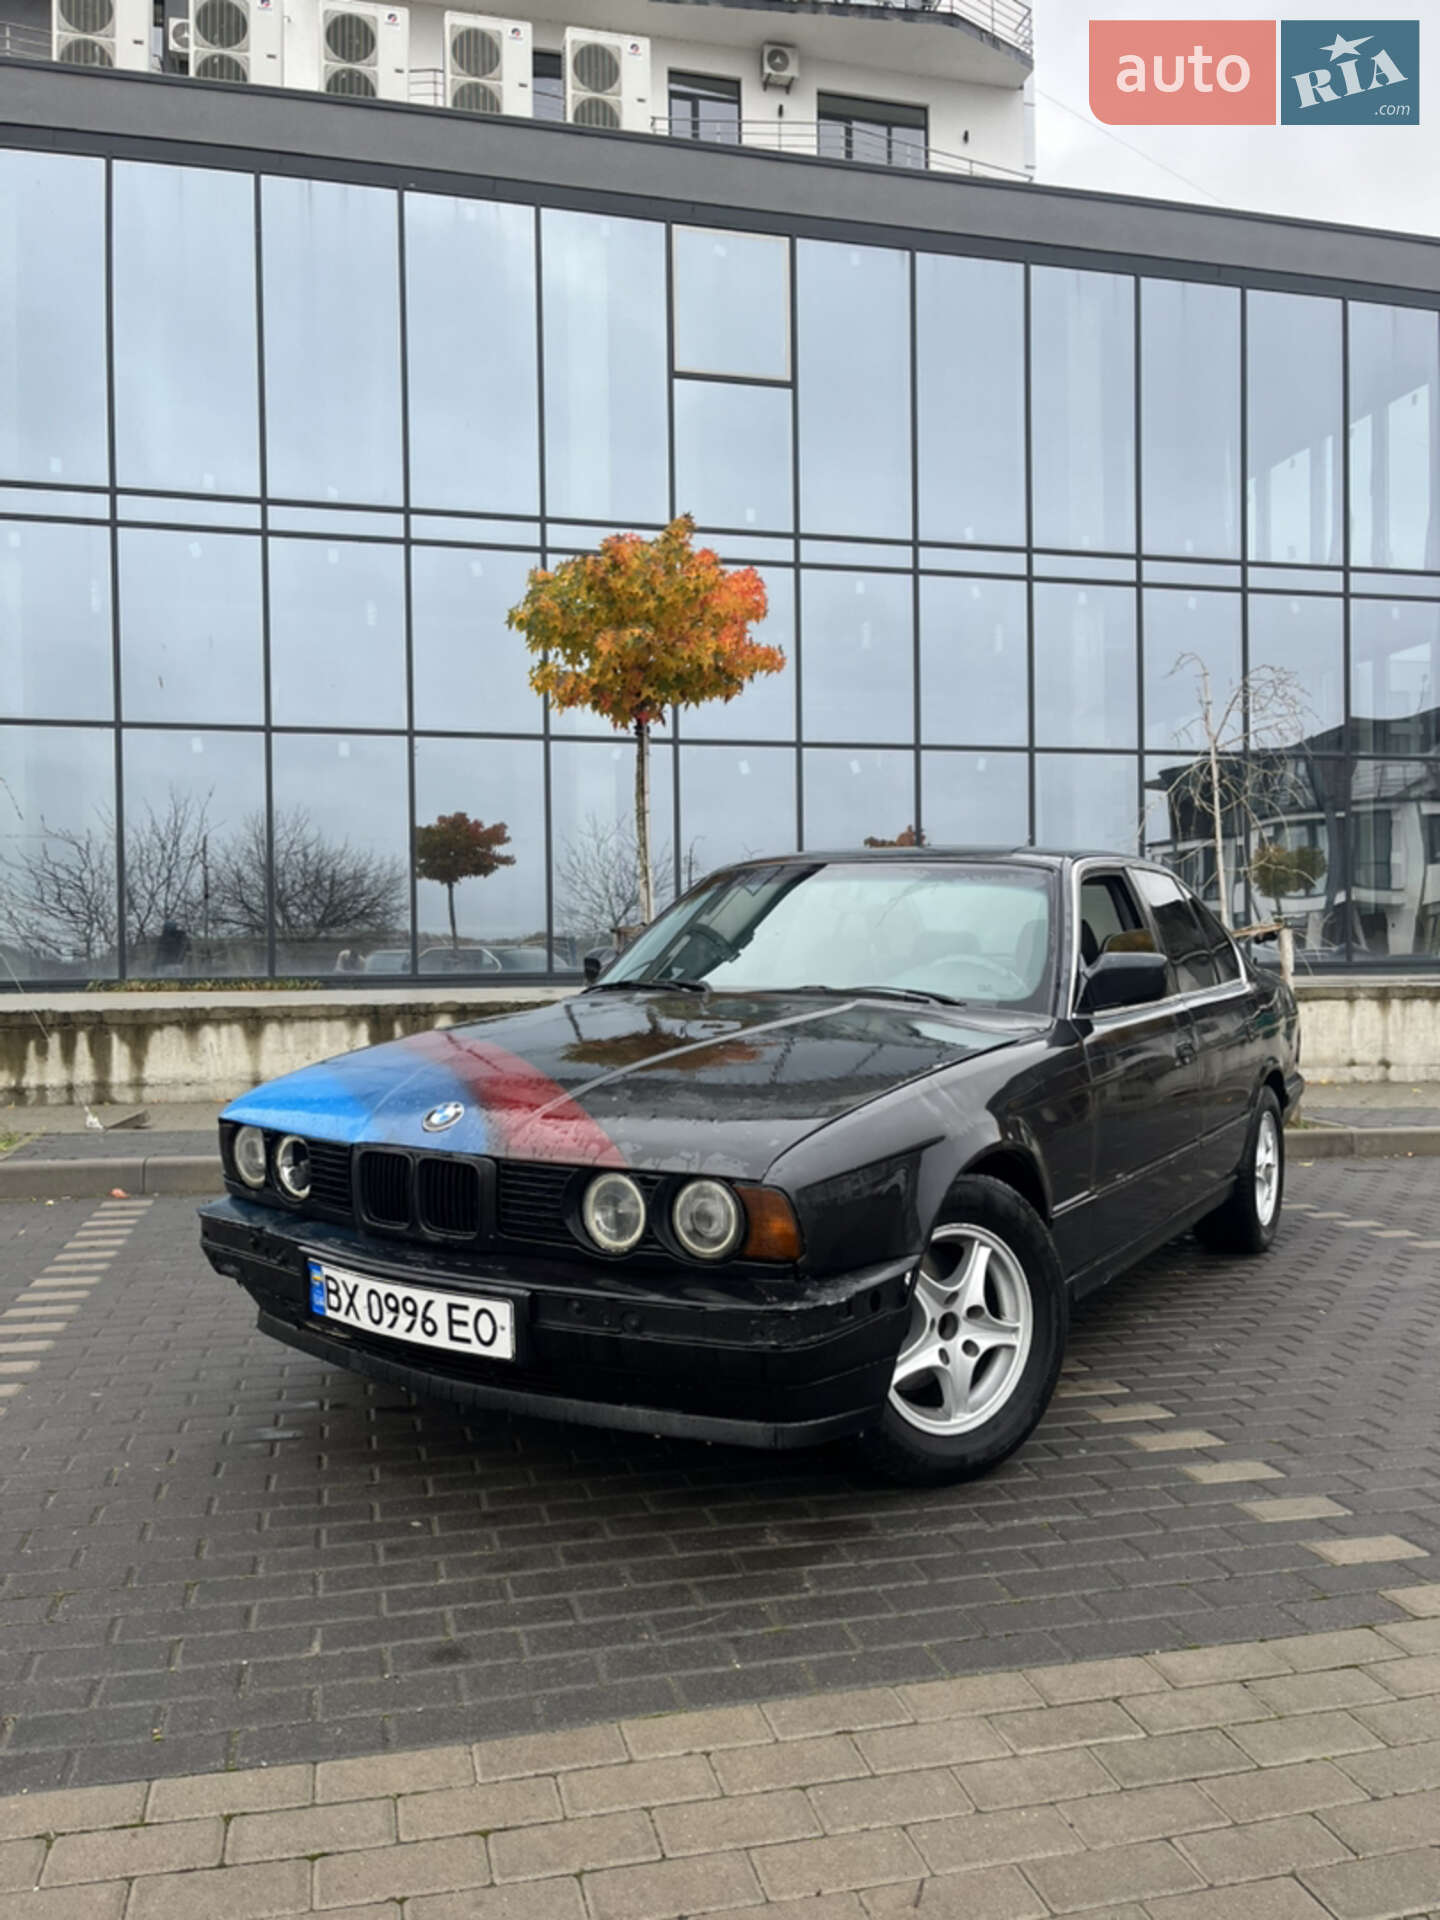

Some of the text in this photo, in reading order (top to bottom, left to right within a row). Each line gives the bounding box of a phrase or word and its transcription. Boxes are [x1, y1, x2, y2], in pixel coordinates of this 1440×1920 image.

[325, 1274, 498, 1347] BX 0996 EO
